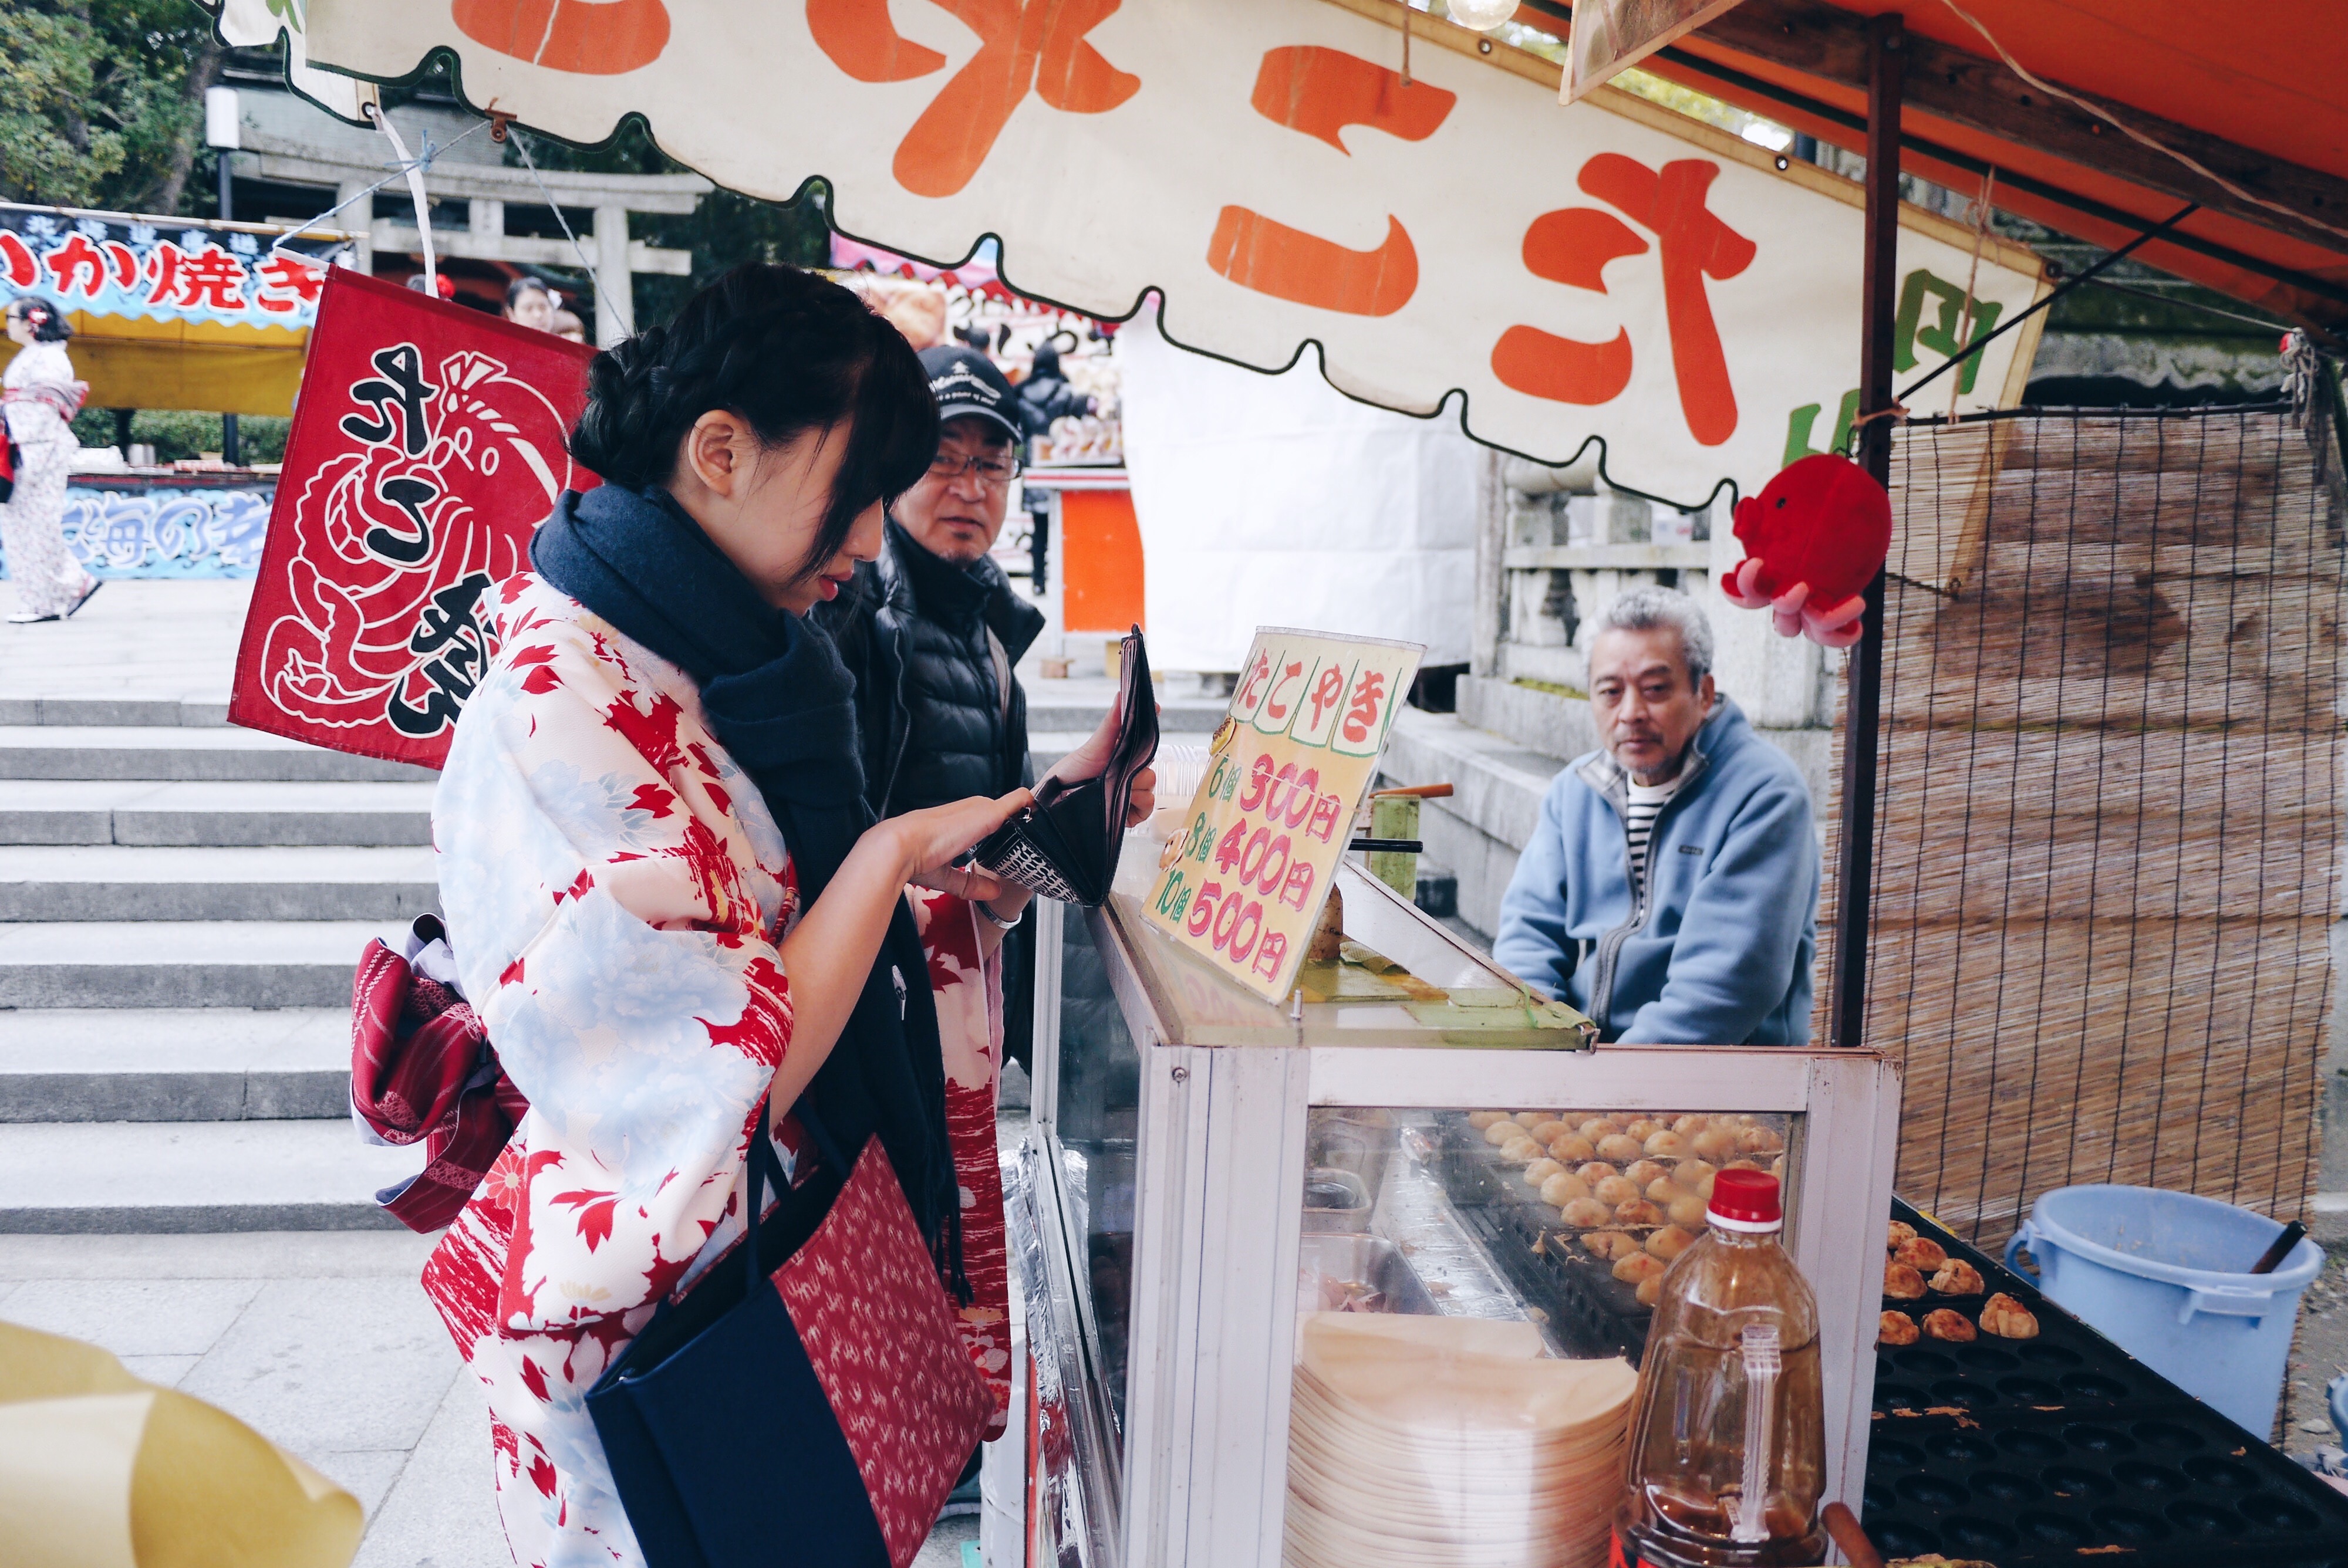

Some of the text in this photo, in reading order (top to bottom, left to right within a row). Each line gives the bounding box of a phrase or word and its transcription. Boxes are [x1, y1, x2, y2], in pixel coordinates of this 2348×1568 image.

[1237, 648, 1384, 743] たこやき
[1239, 753, 1341, 844] 300円
[1215, 817, 1315, 912] 400円
[1187, 877, 1288, 983] 500円
